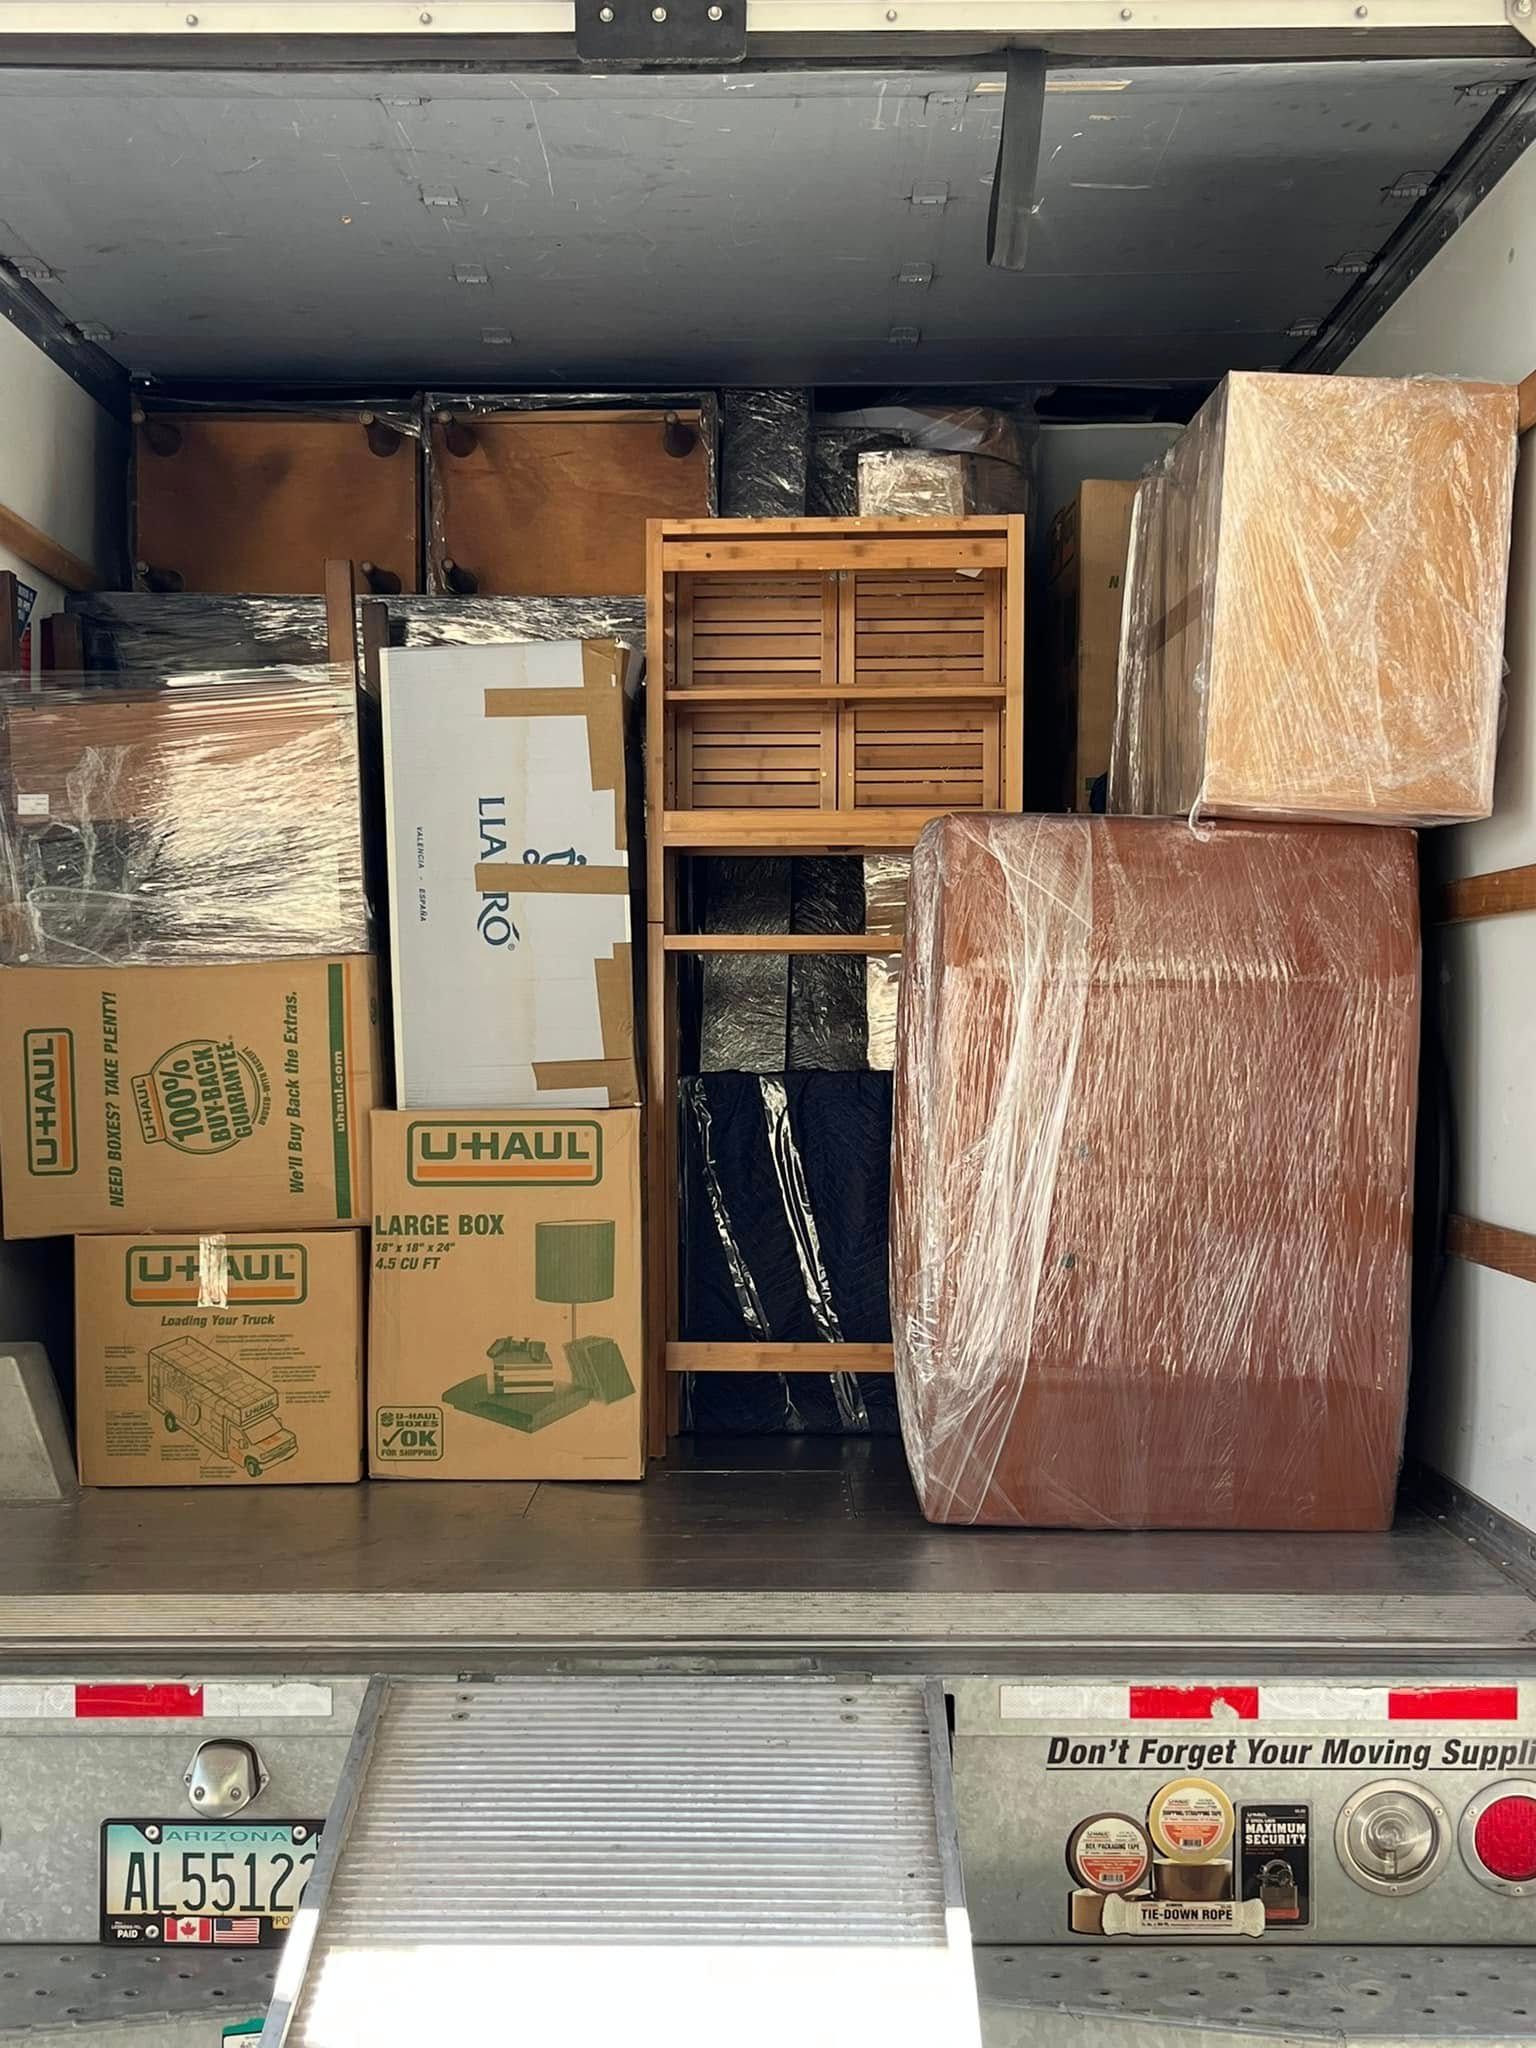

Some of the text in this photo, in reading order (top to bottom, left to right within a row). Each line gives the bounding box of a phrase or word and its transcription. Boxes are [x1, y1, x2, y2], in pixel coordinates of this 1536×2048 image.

[417, 826, 425, 868] VALENCIA
[477, 796, 520, 946] LLARÓ
[419, 888, 427, 921] ESPAÑA
[33, 1038, 57, 1165] U-HAUL
[102, 991, 124, 1207] NEED BOXES? TAKE PLENTY!
[160, 1059, 204, 1142] 100%
[192, 1047, 232, 1143] BUY-BACK
[216, 1041, 253, 1138] GUARANTEE
[283, 991, 304, 1193] We'll Buy Back the Extras.
[334, 1051, 346, 1132] uhaul.com
[136, 1079, 157, 1139] U-HAUL
[421, 1132, 590, 1160] U-HAUL
[375, 1214, 504, 1236] LARGE BOX
[376, 1243, 394, 1252] 18"
[406, 1243, 424, 1252] 18"
[436, 1243, 455, 1252] 24"
[376, 1257, 441, 1270] 4.5 CU FT
[161, 1314, 276, 1328] Loading Your Truck
[401, 1430, 437, 1447] OK
[1047, 1737, 1130, 1764] Don't
[1138, 1739, 1237, 1770] Forget
[1248, 1739, 1312, 1764] Your
[1321, 1739, 1431, 1770] Moving
[167, 1831, 288, 1843] ARIZONA
[1245, 1823, 1306, 1833] MAXIMUM
[1245, 1834, 1307, 1845] SECURITY
[1141, 1909, 1233, 1920] TIE-DOWN ROPE
[117, 1929, 138, 1938] PAID
